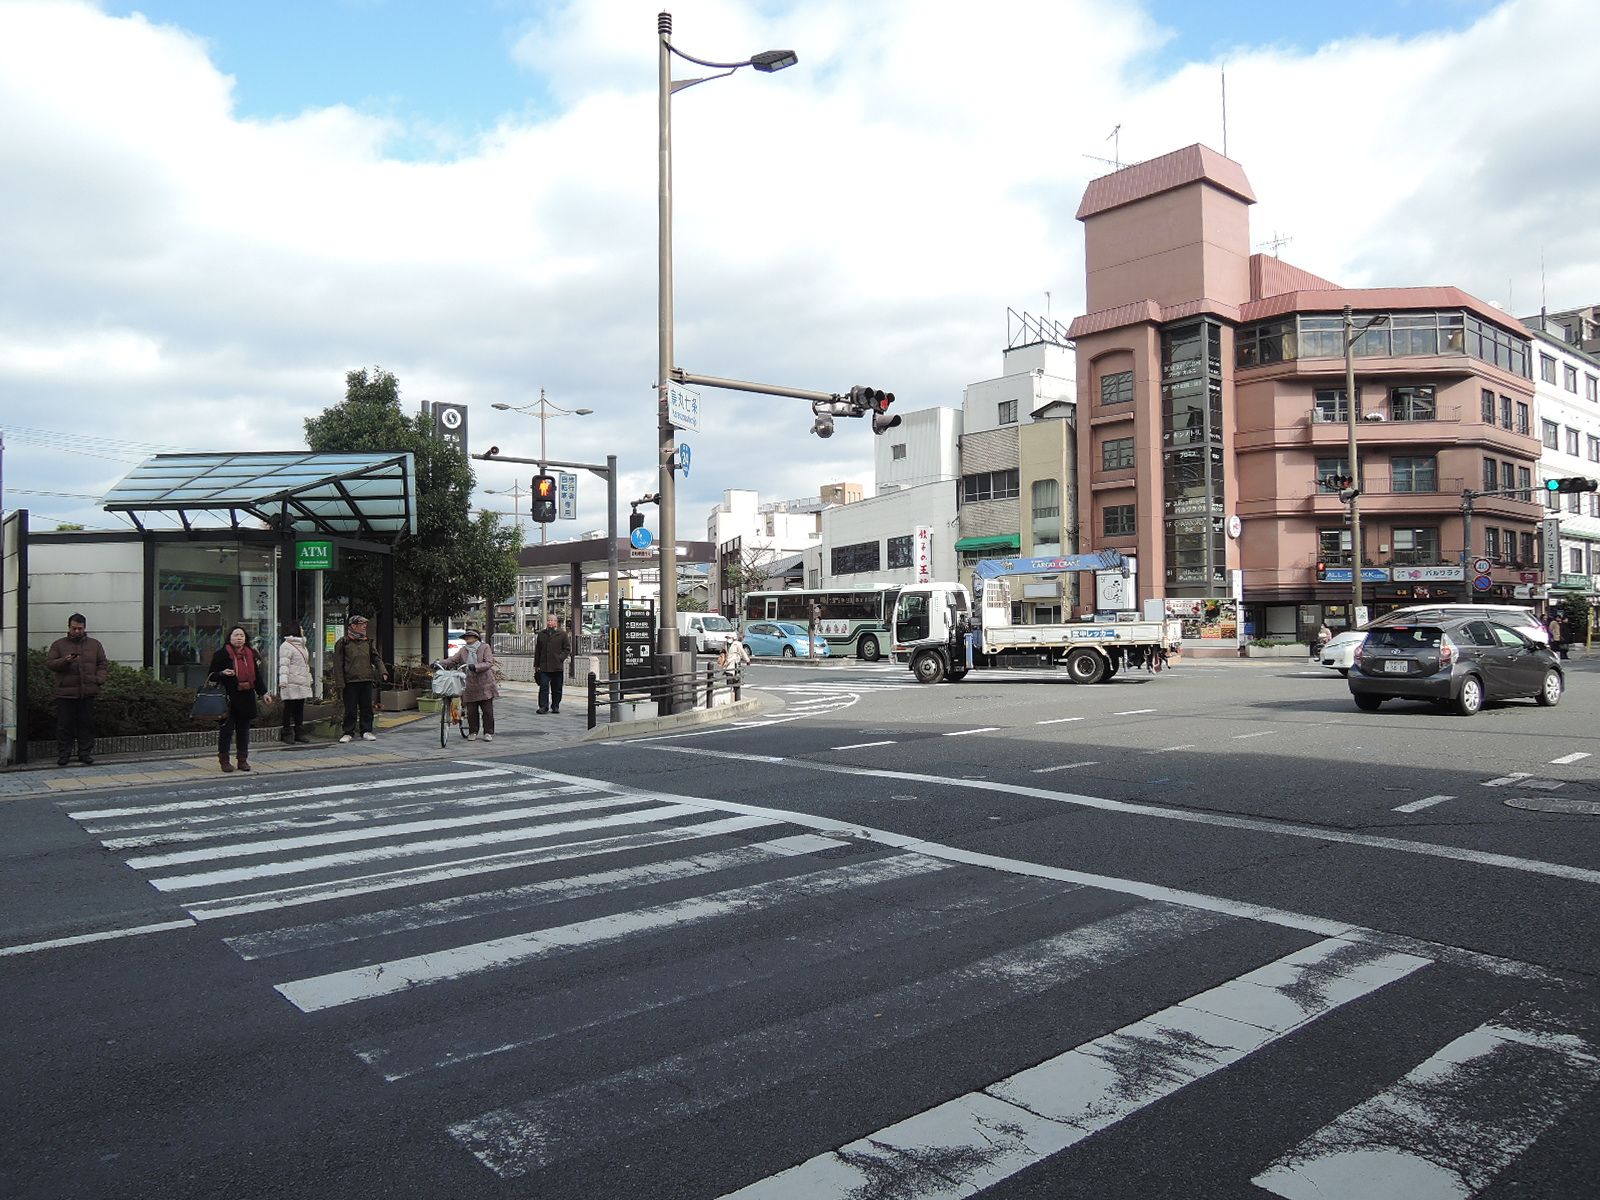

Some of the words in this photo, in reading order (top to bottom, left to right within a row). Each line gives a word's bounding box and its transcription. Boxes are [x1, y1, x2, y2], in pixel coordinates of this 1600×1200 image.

[300, 546, 327, 557] ATM
[1032, 561, 1056, 569] CARGO
[1477, 562, 1488, 570] 40
[169, 604, 222, 614] キャッシュサービス
